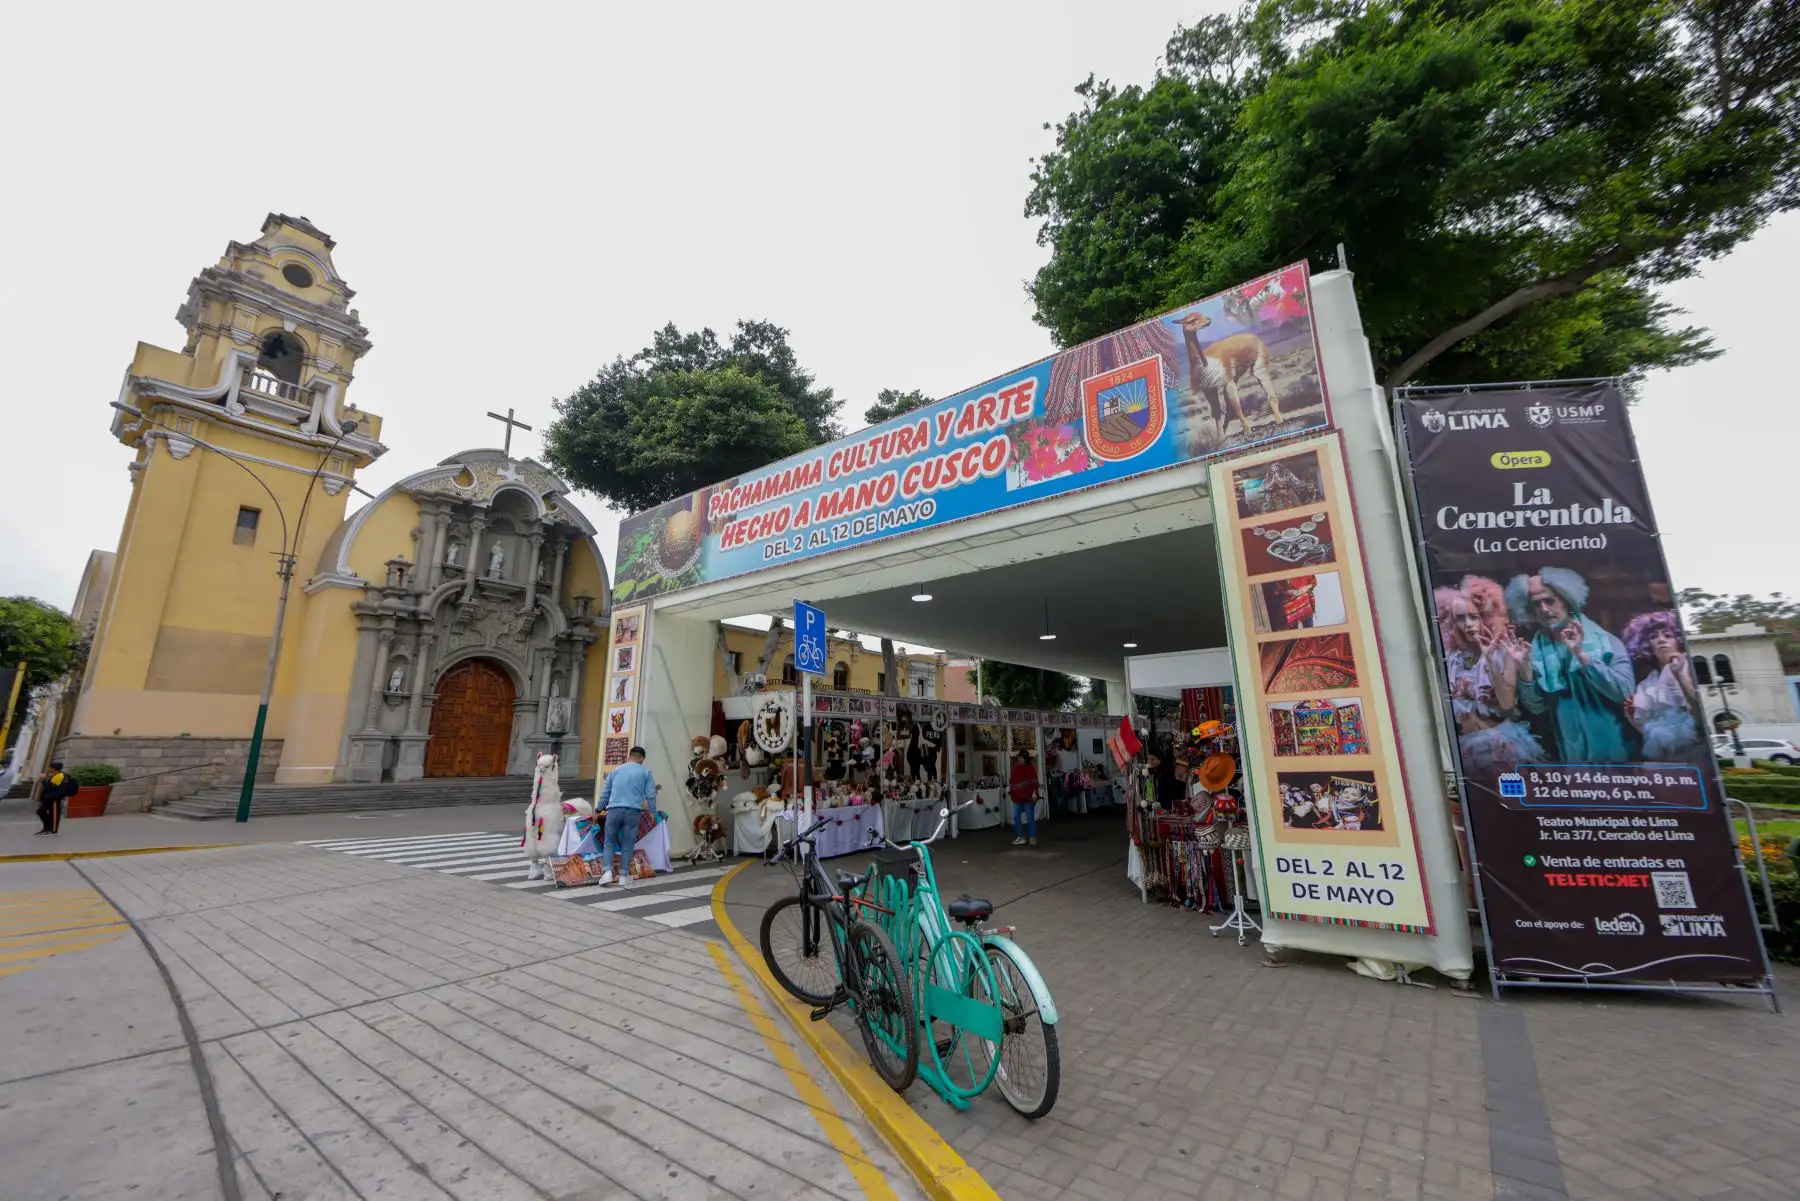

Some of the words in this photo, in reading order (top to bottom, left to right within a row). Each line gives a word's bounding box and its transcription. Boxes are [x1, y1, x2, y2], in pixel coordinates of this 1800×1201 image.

[1556, 404, 1605, 418] USMP
[1448, 413, 1510, 430] LIMA
[708, 460, 823, 520] PACHAMAMA
[828, 421, 928, 477] CULTURA
[938, 410, 954, 441] Y
[956, 381, 1036, 436] ARTE
[1500, 452, 1543, 466] Ópera
[720, 510, 789, 549] HECHO
[793, 501, 809, 527] A
[815, 475, 895, 521] MANO
[903, 438, 1010, 495] CUSCO
[1513, 482, 1553, 506] La
[1436, 498, 1635, 531] Cenerentola
[764, 541, 790, 559] DEL
[793, 536, 802, 551] 2
[809, 530, 828, 548] AL
[832, 525, 848, 541] 12
[853, 518, 875, 536] DE
[880, 500, 935, 530] MAYO
[1474, 537, 1501, 553] (La
[1505, 533, 1607, 552] Cenicienta)
[806, 610, 815, 631] P
[1530, 772, 1543, 785] 8,
[1545, 772, 1562, 783] 10
[1564, 774, 1572, 786] y
[1575, 772, 1592, 784] 14
[1595, 772, 1610, 784] de
[1612, 775, 1653, 787] mayo,
[1654, 773, 1664, 785] 8
[1665, 776, 1678, 787] p.
[1679, 775, 1698, 786] m.
[1533, 787, 1550, 798] 12
[1552, 787, 1569, 798] de
[1570, 789, 1610, 800] mayo,
[1612, 788, 1622, 799] 6
[1623, 790, 1636, 801] p.
[1638, 789, 1655, 800] m.
[1536, 816, 1573, 828] Teatro
[1574, 816, 1631, 830] Municipal
[1631, 817, 1648, 828] de
[1648, 816, 1679, 828] Lima
[1539, 830, 1553, 842] Jr.
[1554, 830, 1571, 842] Ica
[1572, 830, 1597, 843] 377,
[1598, 830, 1647, 842] Cercado
[1647, 830, 1663, 842] de
[1664, 830, 1695, 842] Lima
[1276, 857, 1317, 875] DEL
[1321, 859, 1335, 876] 2
[1346, 861, 1375, 879] AL
[1379, 863, 1405, 881] 12
[1540, 855, 1581, 869] Venta
[1583, 855, 1601, 869] de
[1603, 855, 1664, 869] entradas
[1667, 857, 1685, 869] en
[1543, 873, 1650, 888] TELETICKET
[1292, 883, 1321, 900] DE
[1327, 885, 1394, 906] MAYO
[1515, 919, 1533, 929] Con
[1534, 919, 1543, 929] el
[1544, 920, 1570, 931] apoyo
[1570, 919, 1585, 930] de:
[1680, 922, 1727, 937] LIMA
